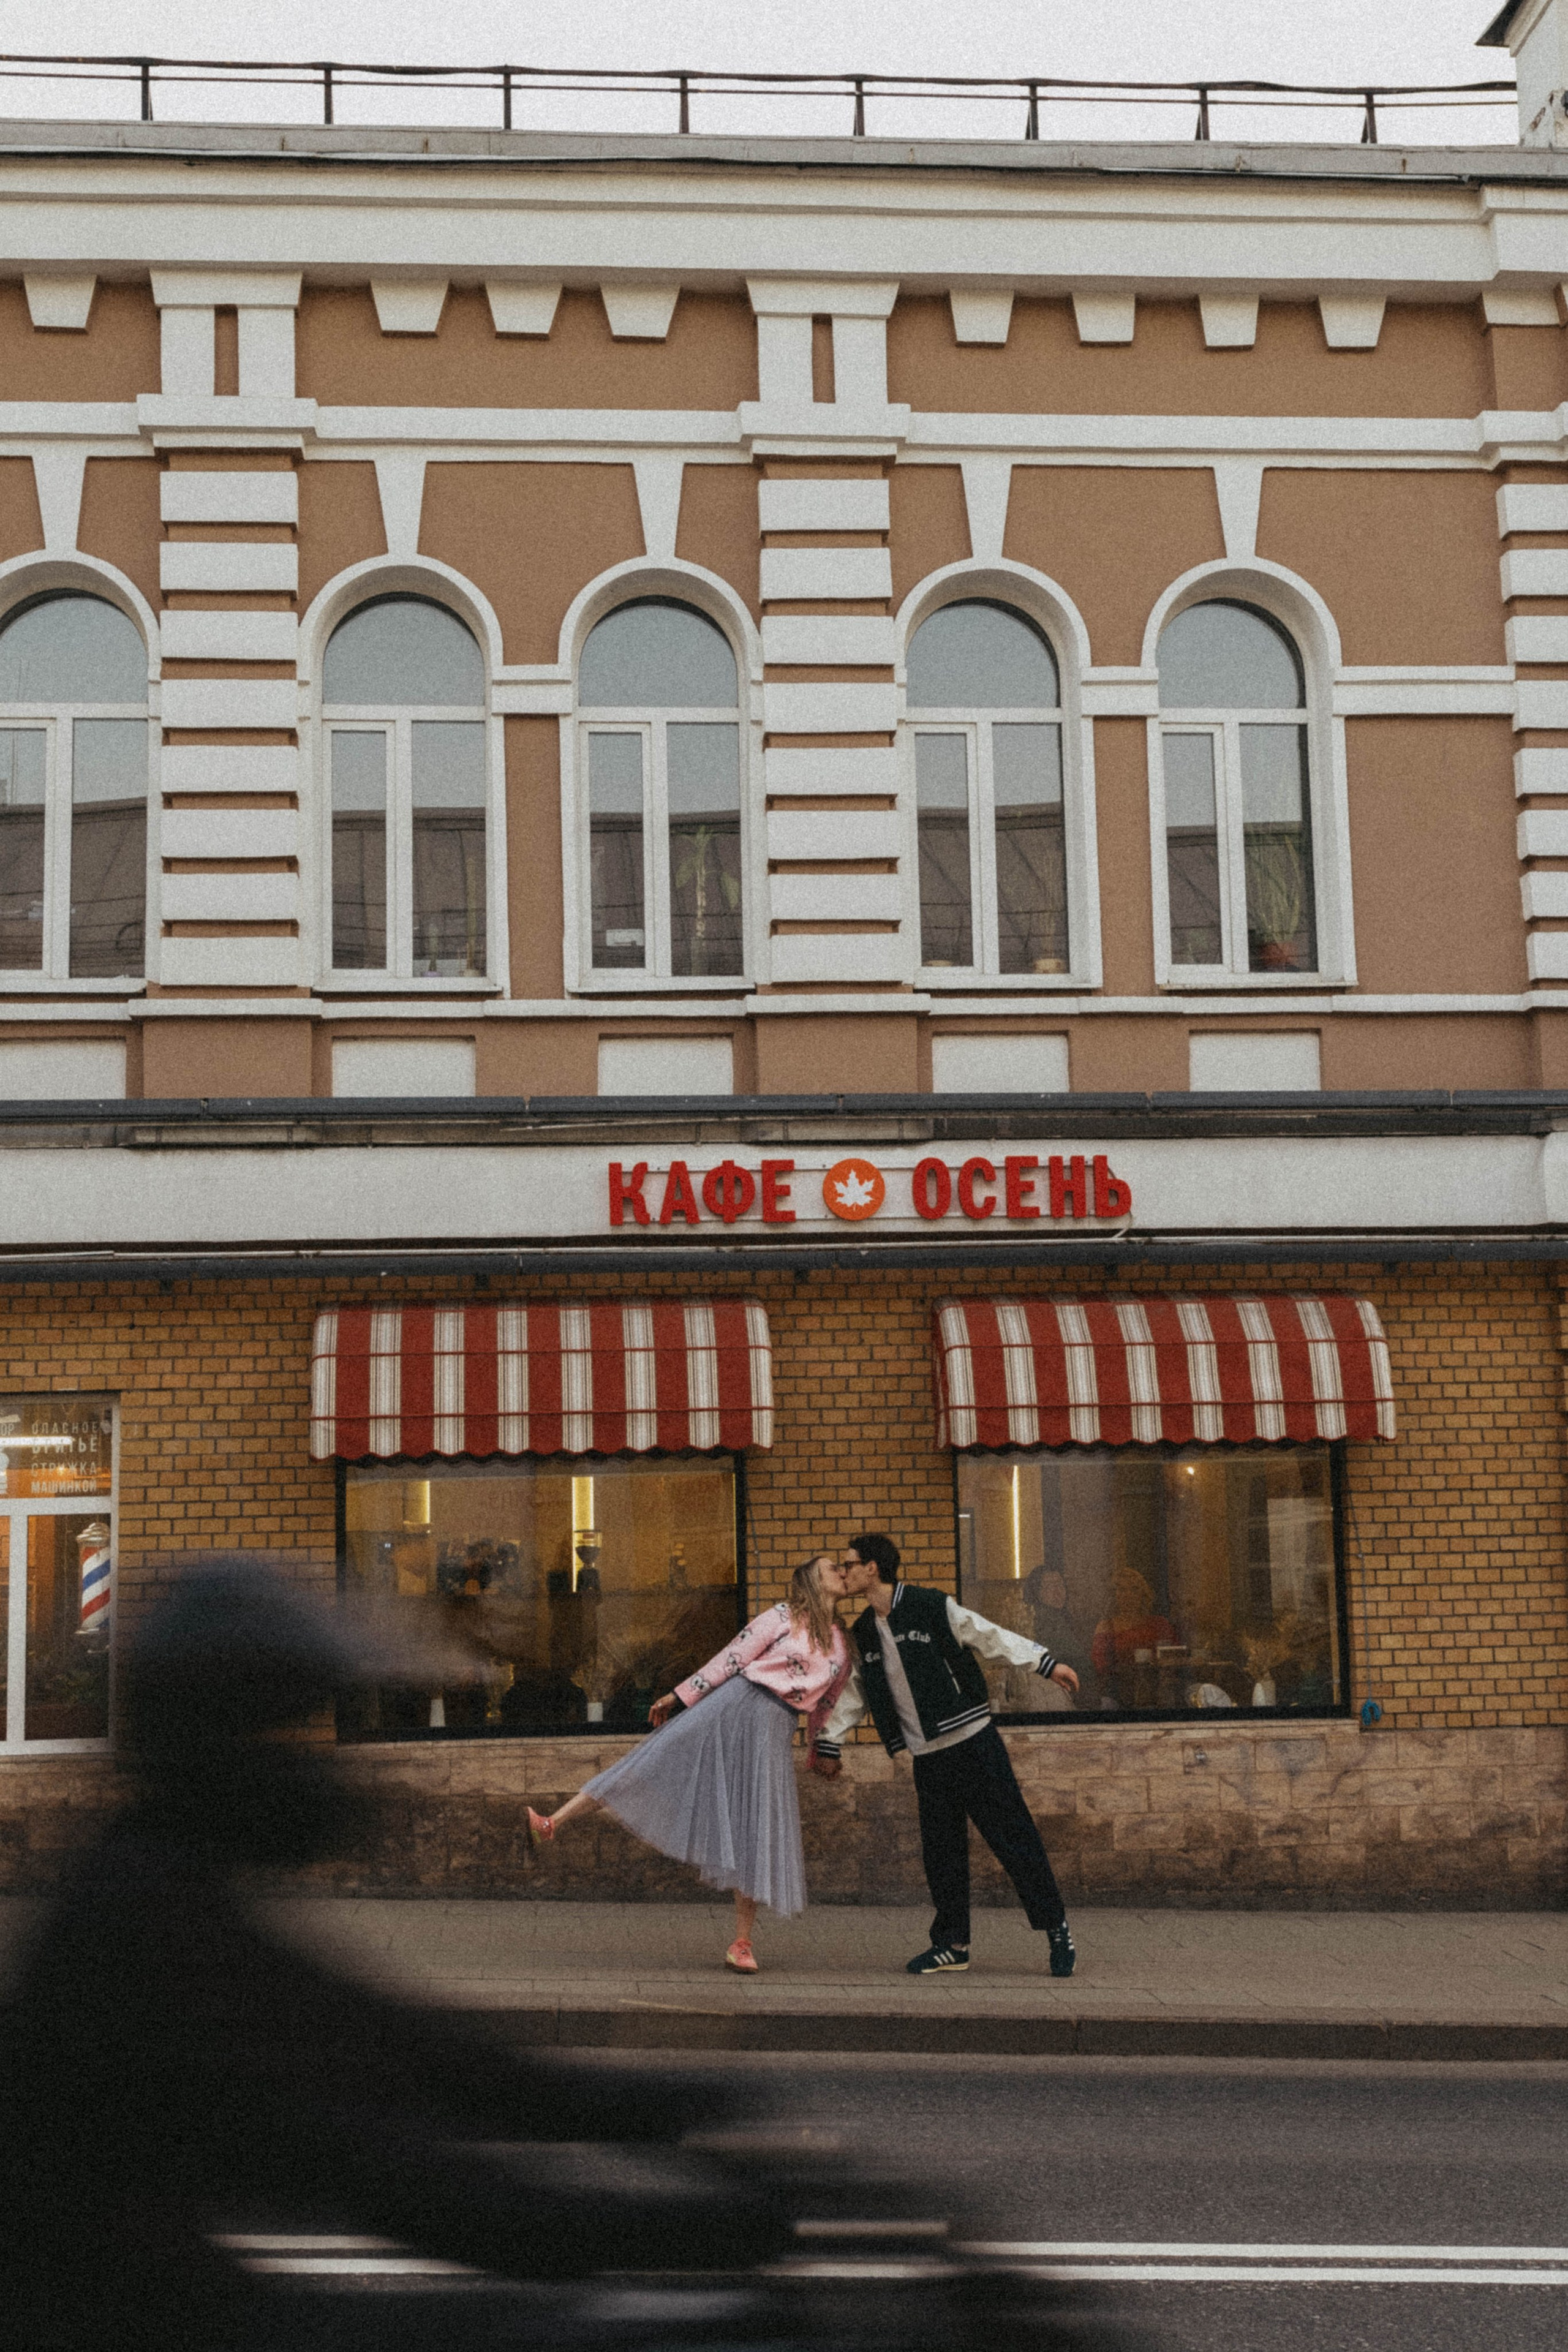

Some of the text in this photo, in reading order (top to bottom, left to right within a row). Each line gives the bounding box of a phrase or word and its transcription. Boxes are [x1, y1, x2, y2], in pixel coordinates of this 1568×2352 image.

[608, 1155, 1133, 1225] КАФЕ ОСЕНЬ
[32, 1422, 98, 1434] ОПАСНОЕ
[31, 1461, 97, 1477] СТРИЖКА
[31, 1479, 97, 1494] МАШИНКОЙ
[908, 1630, 931, 1643] Club
